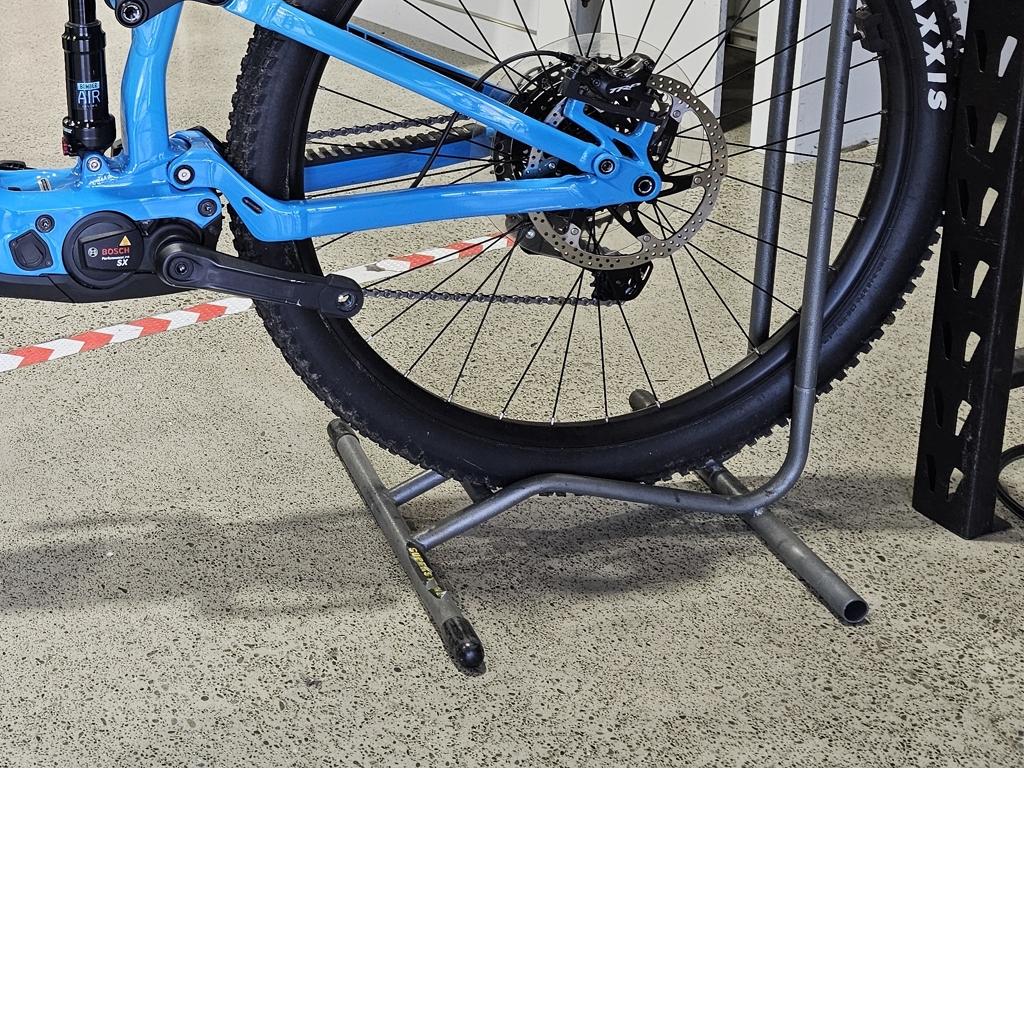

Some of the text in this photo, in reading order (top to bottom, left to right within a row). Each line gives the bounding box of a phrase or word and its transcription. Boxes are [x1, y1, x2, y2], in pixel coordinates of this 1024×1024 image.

[77, 90, 101, 104] AIR
[102, 247, 130, 255] BOSCH
[117, 259, 129, 267] SX
